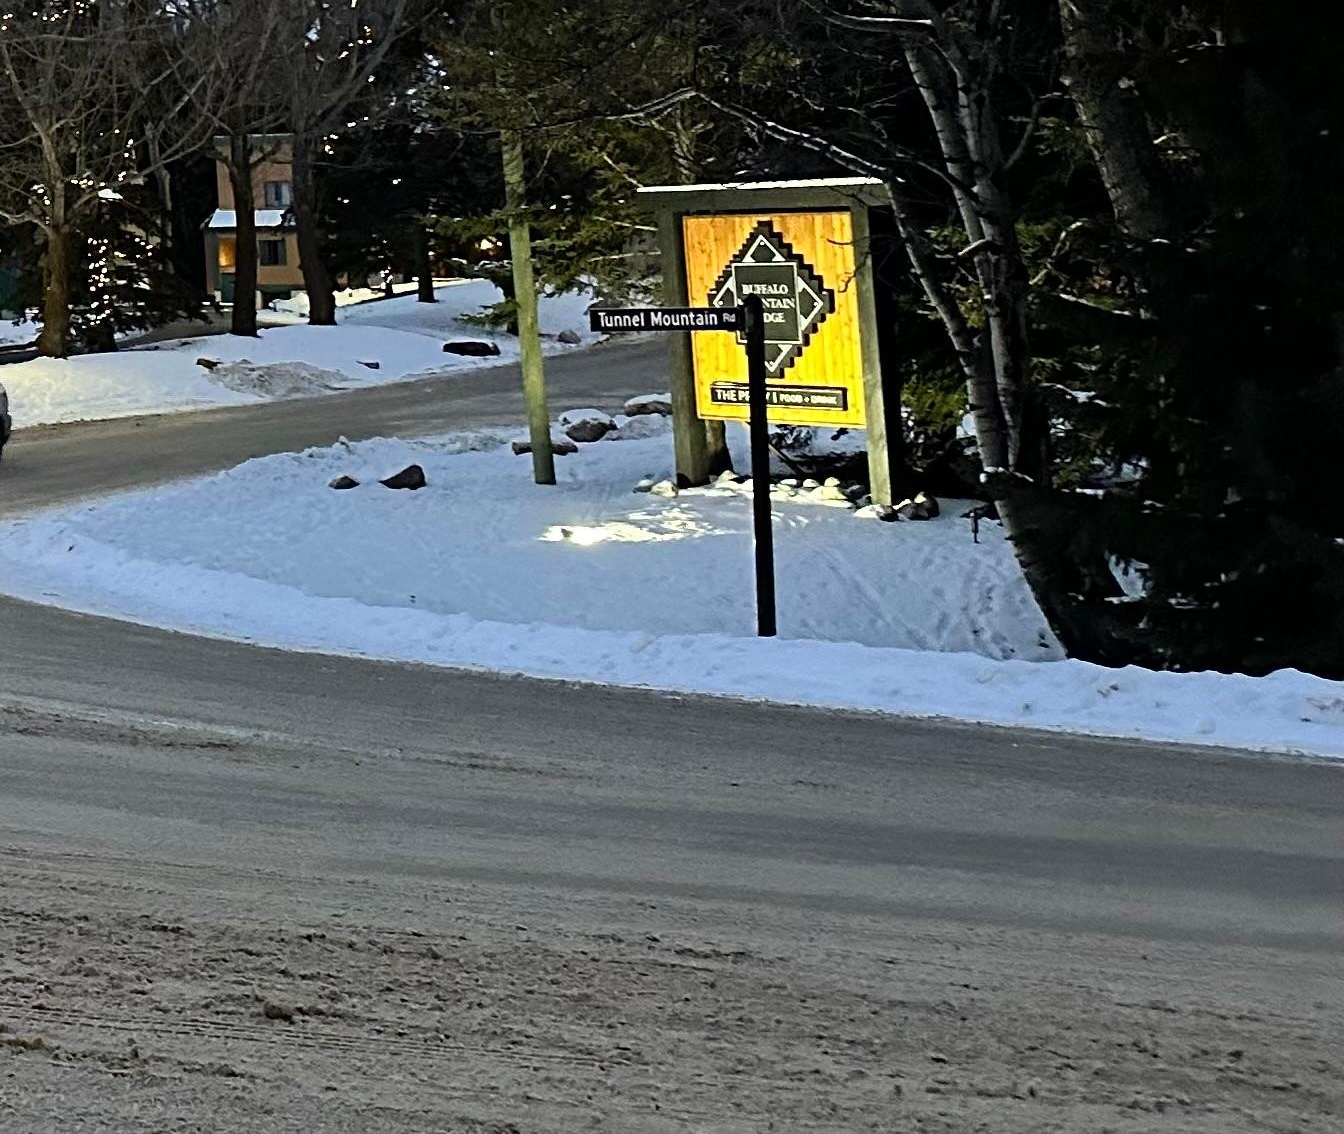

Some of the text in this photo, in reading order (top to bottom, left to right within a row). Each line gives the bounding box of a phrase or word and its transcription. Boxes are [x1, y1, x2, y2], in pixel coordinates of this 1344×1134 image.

[741, 283, 789, 295] BUFFALO
[737, 297, 796, 309] NTAIN
[597, 310, 736, 328] Tunnel Mountain Rd
[715, 388, 738, 402] THE
